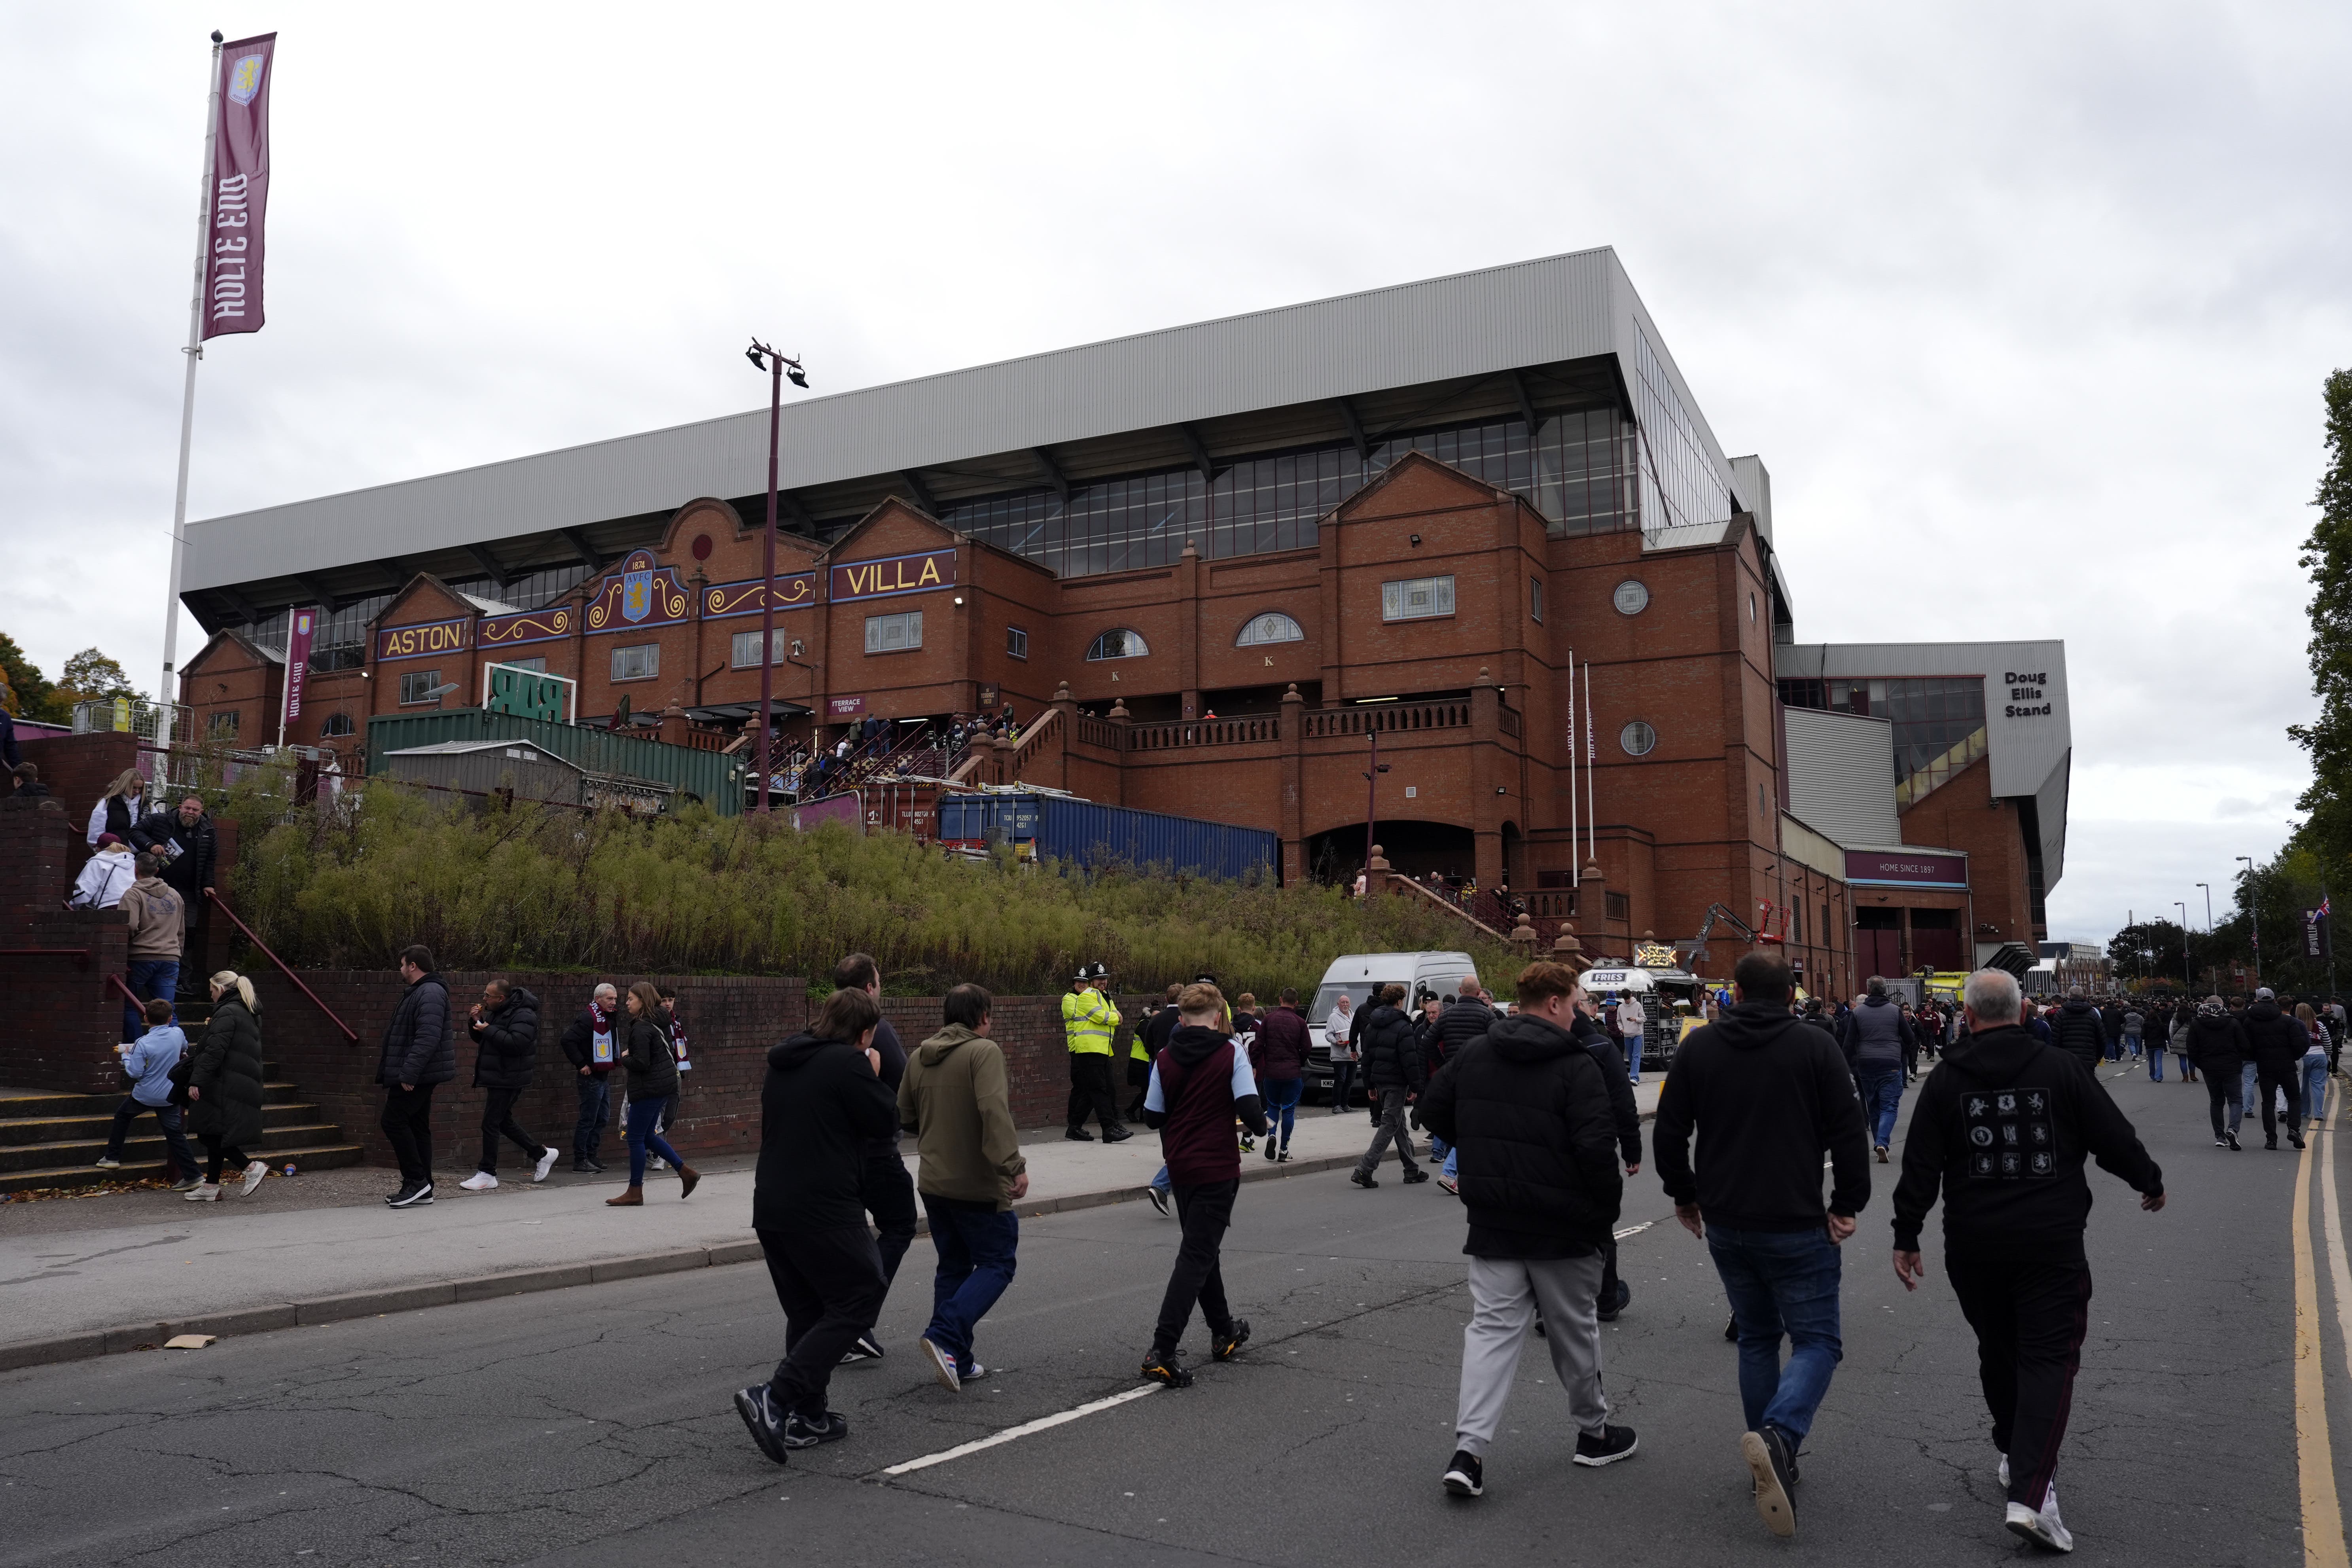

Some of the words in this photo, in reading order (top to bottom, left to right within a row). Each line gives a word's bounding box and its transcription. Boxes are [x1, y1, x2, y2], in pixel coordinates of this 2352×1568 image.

[216, 173, 248, 229] END
[214, 236, 248, 322] HOLTE
[633, 561, 646, 570] 1874
[627, 572, 650, 583] AVFC
[846, 557, 941, 594] VILLA
[386, 623, 460, 656] ASTON
[1264, 656, 1274, 667] K
[293, 662, 303, 683] END
[1111, 671, 1119, 682] K
[2005, 672, 2047, 684] Doug
[2012, 687, 2042, 699] Ellis
[289, 685, 299, 717] HOLTE
[834, 699, 860, 707] TERRACE
[2005, 703, 2051, 717] Stand
[1880, 863, 1898, 872] HOME
[1900, 864, 1918, 873] SINCE
[1920, 865, 1935, 873] 1897
[2307, 924, 2318, 941] VILLA!
